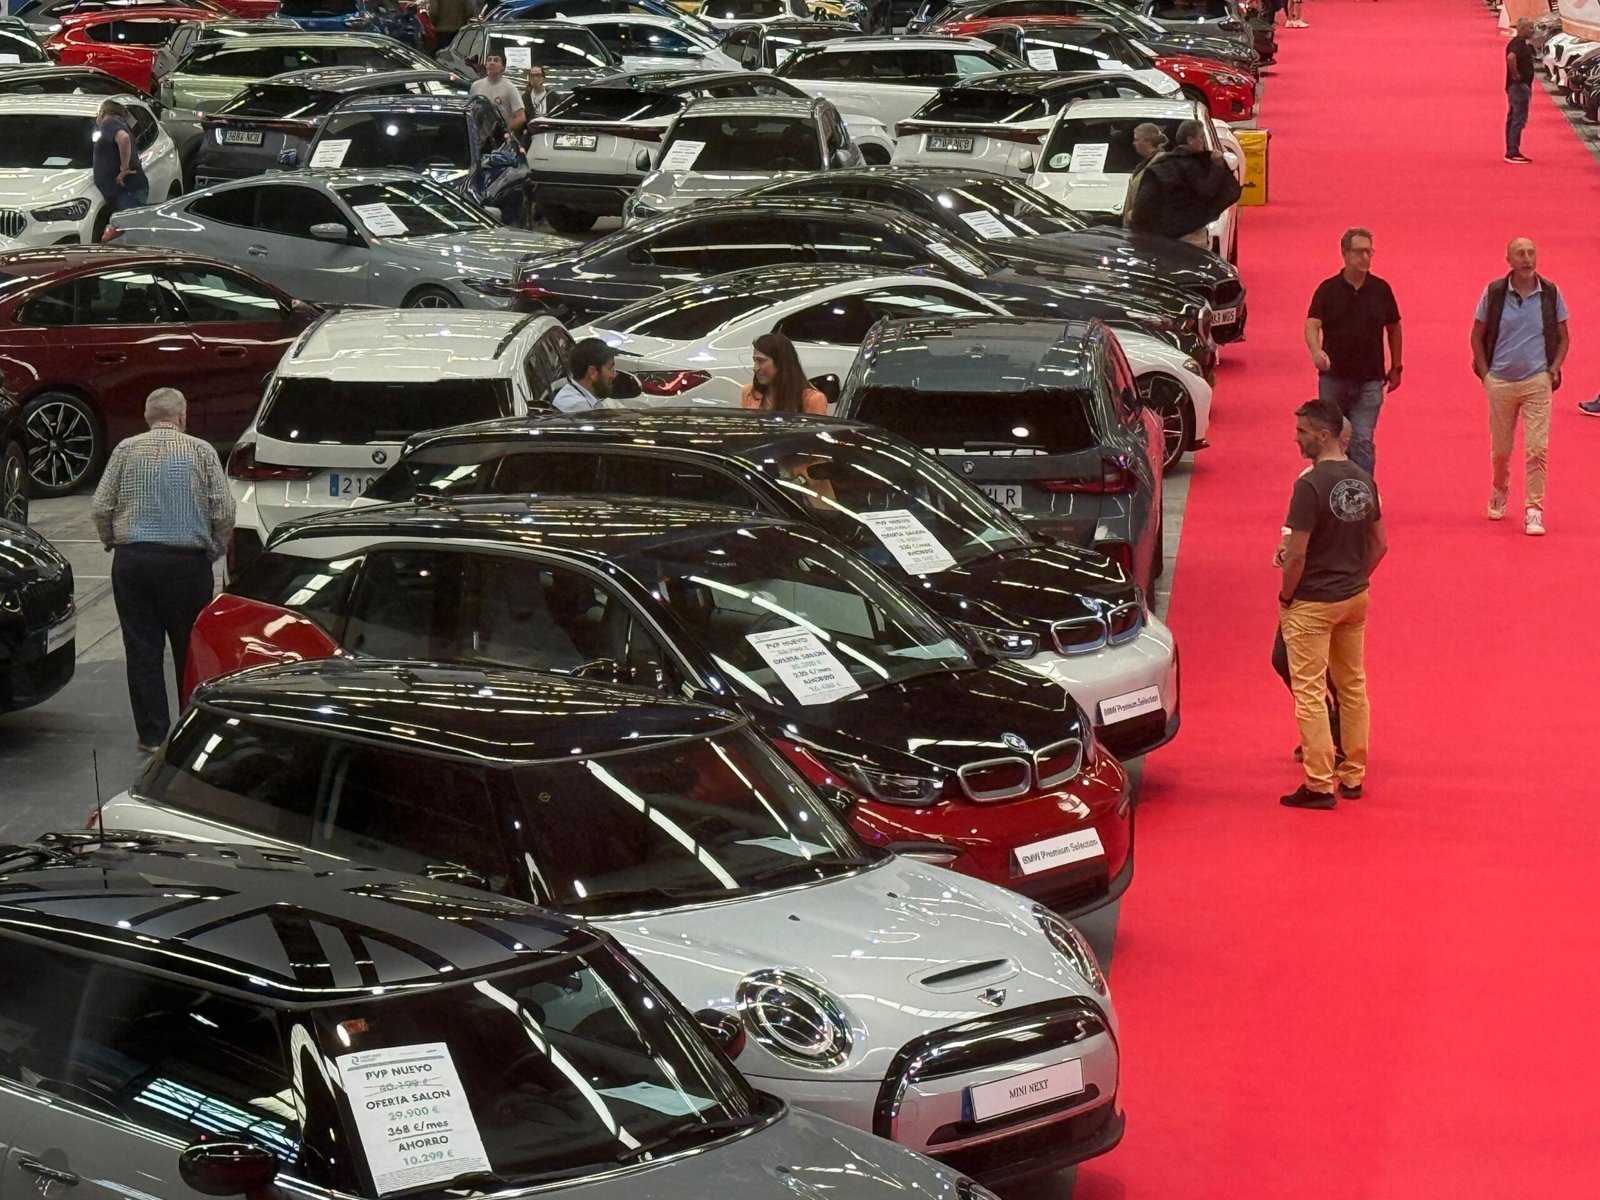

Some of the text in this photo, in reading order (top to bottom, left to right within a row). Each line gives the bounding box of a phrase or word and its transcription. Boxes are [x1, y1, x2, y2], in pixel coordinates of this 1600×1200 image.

[1021, 839, 1099, 865] BMW Premium Selection
[365, 1063, 433, 1080] PVP NUEVO
[1008, 1079, 1049, 1099] MINI NEXT
[366, 1089, 452, 1110] OFERTA SALON
[388, 1106, 430, 1121] 29.900
[387, 1119, 449, 1137] 368 €/mes
[398, 1135, 449, 1152] AHORRO
[403, 1151, 444, 1166] 10.299
